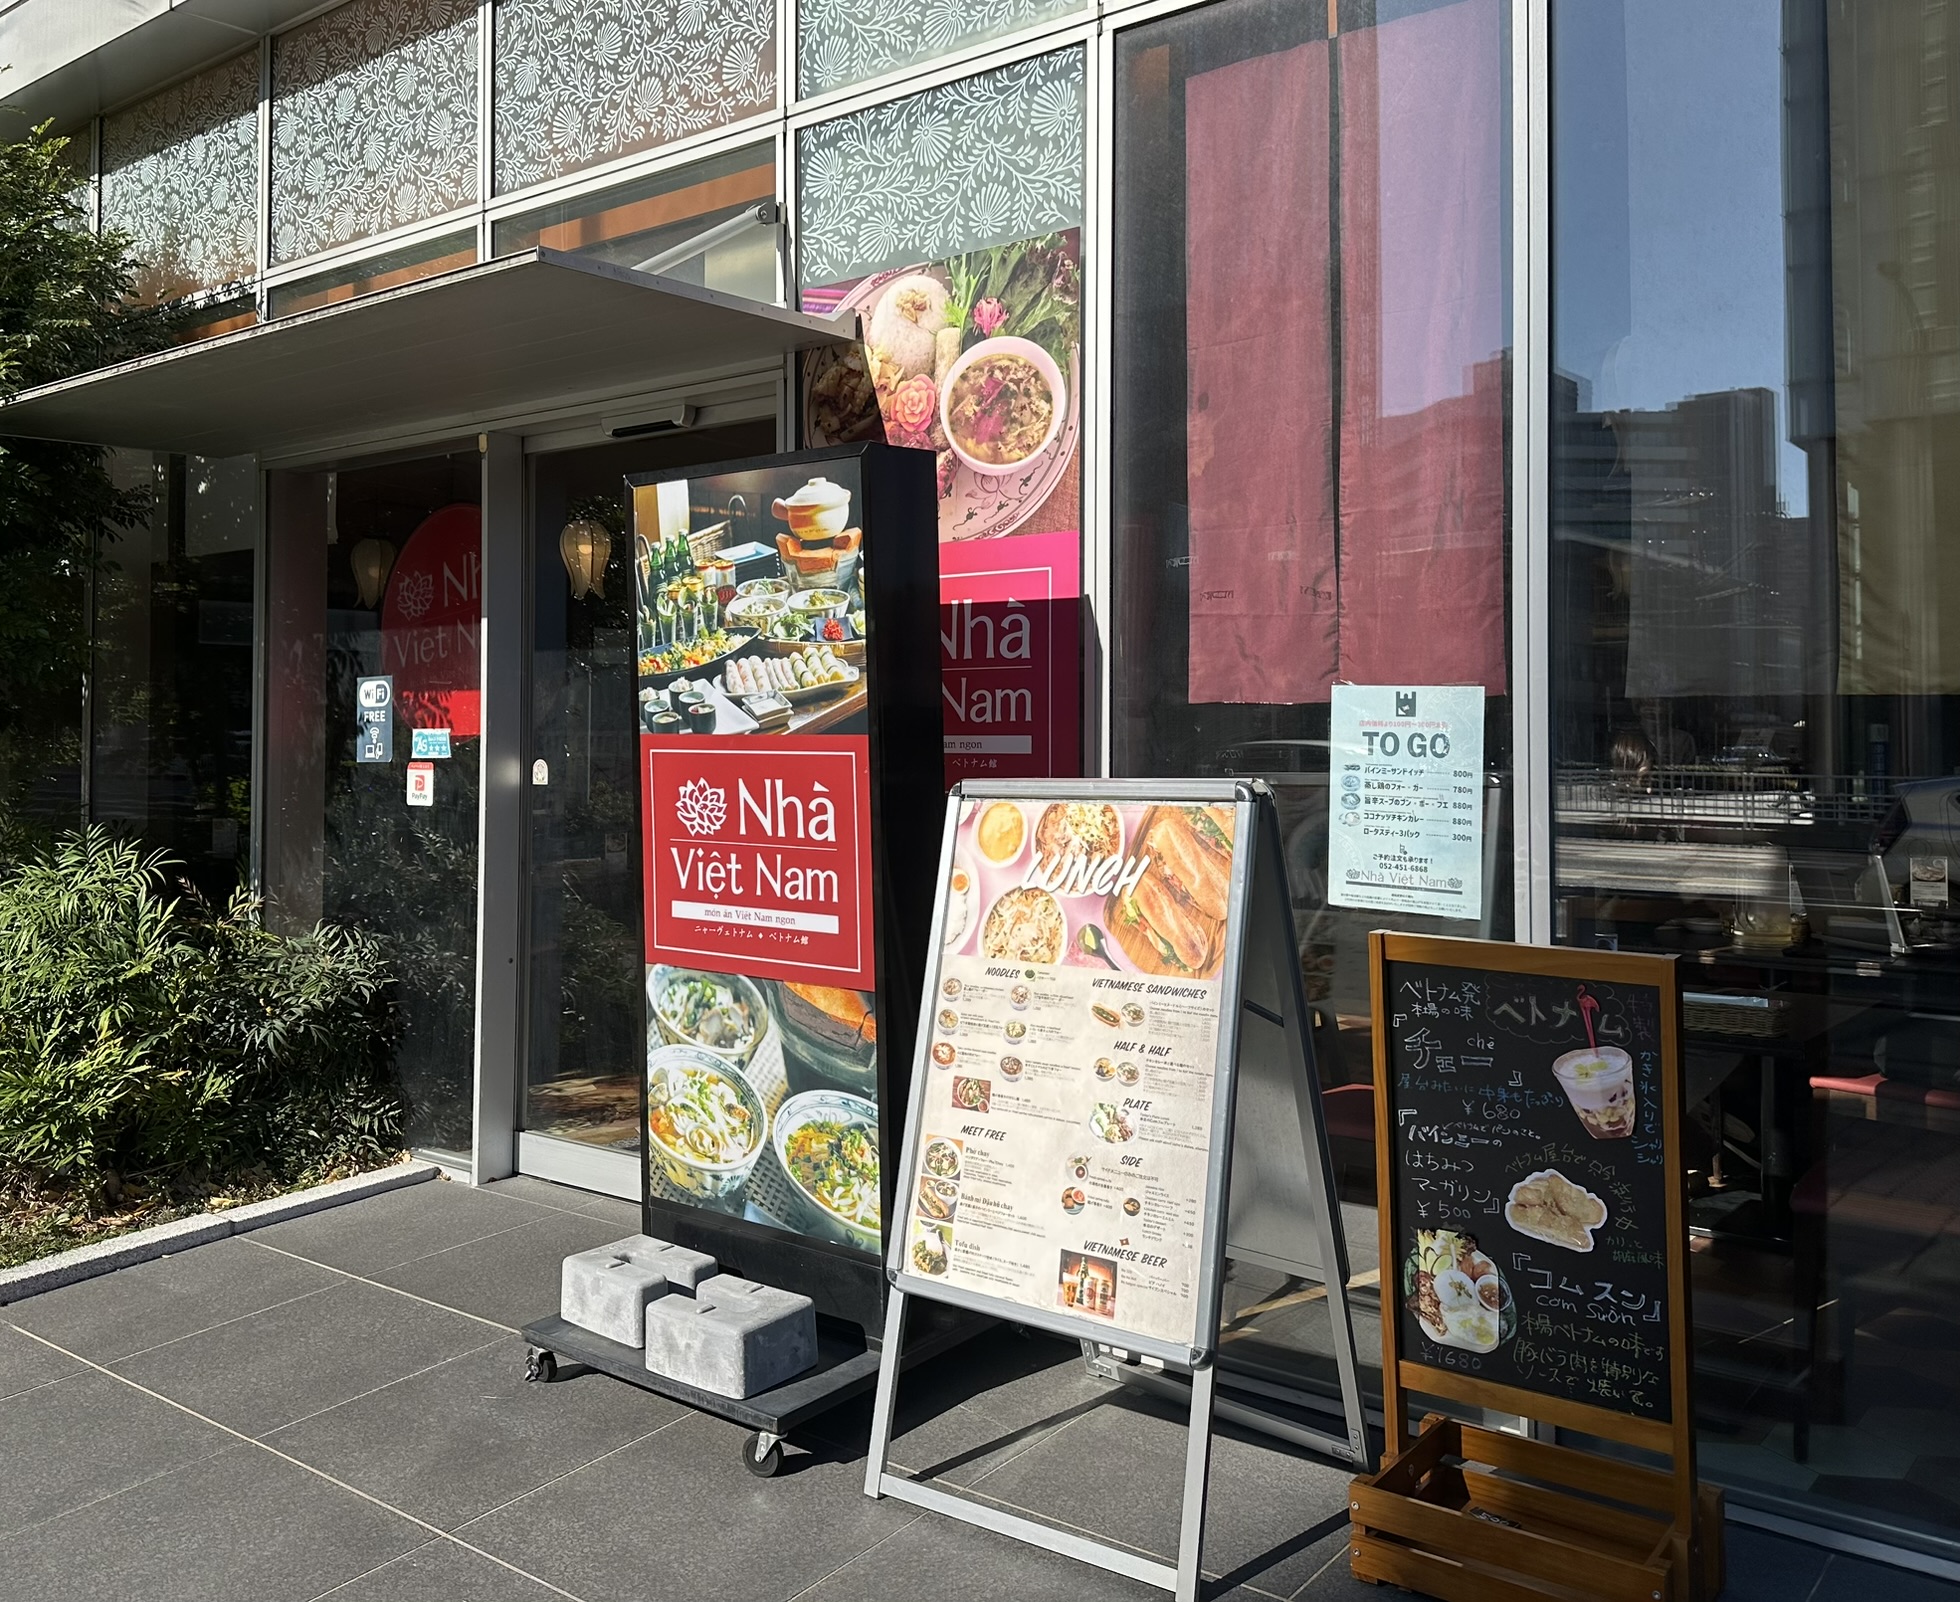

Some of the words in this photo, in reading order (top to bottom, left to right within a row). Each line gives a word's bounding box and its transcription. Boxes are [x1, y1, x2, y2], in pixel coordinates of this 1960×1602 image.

[942, 677, 1032, 723] Nam
[363, 710, 386, 722] FREE
[959, 741, 983, 750] ngon
[1362, 731, 1400, 757] TO
[1407, 732, 1450, 759] GO
[1452, 770, 1473, 779] 800円
[411, 792, 428, 802] PayPay
[1452, 785, 1473, 795] 780円
[738, 777, 837, 843] Nhà
[1452, 801, 1473, 811] 880円
[1363, 812, 1425, 823] ココナッツチキンカレー
[1452, 817, 1472, 827] 880円
[1451, 833, 1472, 843] 300円
[1020, 851, 1151, 898] LUNCH
[1378, 862, 1429, 873] 052-451-6868
[670, 847, 744, 900] Việt
[755, 852, 839, 904] Nam
[1418, 878, 1448, 888] Nam
[754, 911, 773, 923] Nam
[775, 915, 796, 926] ngon
[694, 925, 753, 939] ニャーヴェトナム
[985, 966, 1021, 979] NOODLES
[1092, 977, 1146, 993] VIETNAMESE
[1146, 983, 1208, 1000] SANDWICHES
[1400, 978, 1481, 1005] ベトナム発
[1411, 1002, 1474, 1021] 本場の味
[1494, 992, 1624, 1039] ベトナム
[1113, 1040, 1137, 1052] HALF
[1138, 1043, 1146, 1054] &
[1148, 1045, 1173, 1057] HALF
[1122, 1097, 1153, 1112] PLATE
[1462, 1100, 1520, 1121] ¥680
[960, 1124, 985, 1137] MEET
[984, 1129, 1007, 1142] FREE
[1120, 1154, 1144, 1168] SIDE
[1405, 1149, 1475, 1173] はちみつ
[1416, 1200, 1471, 1219] ¥500
[968, 1241, 981, 1252] dish
[1083, 1239, 1140, 1262] VIETNAMESE
[1140, 1252, 1168, 1269] BEER
